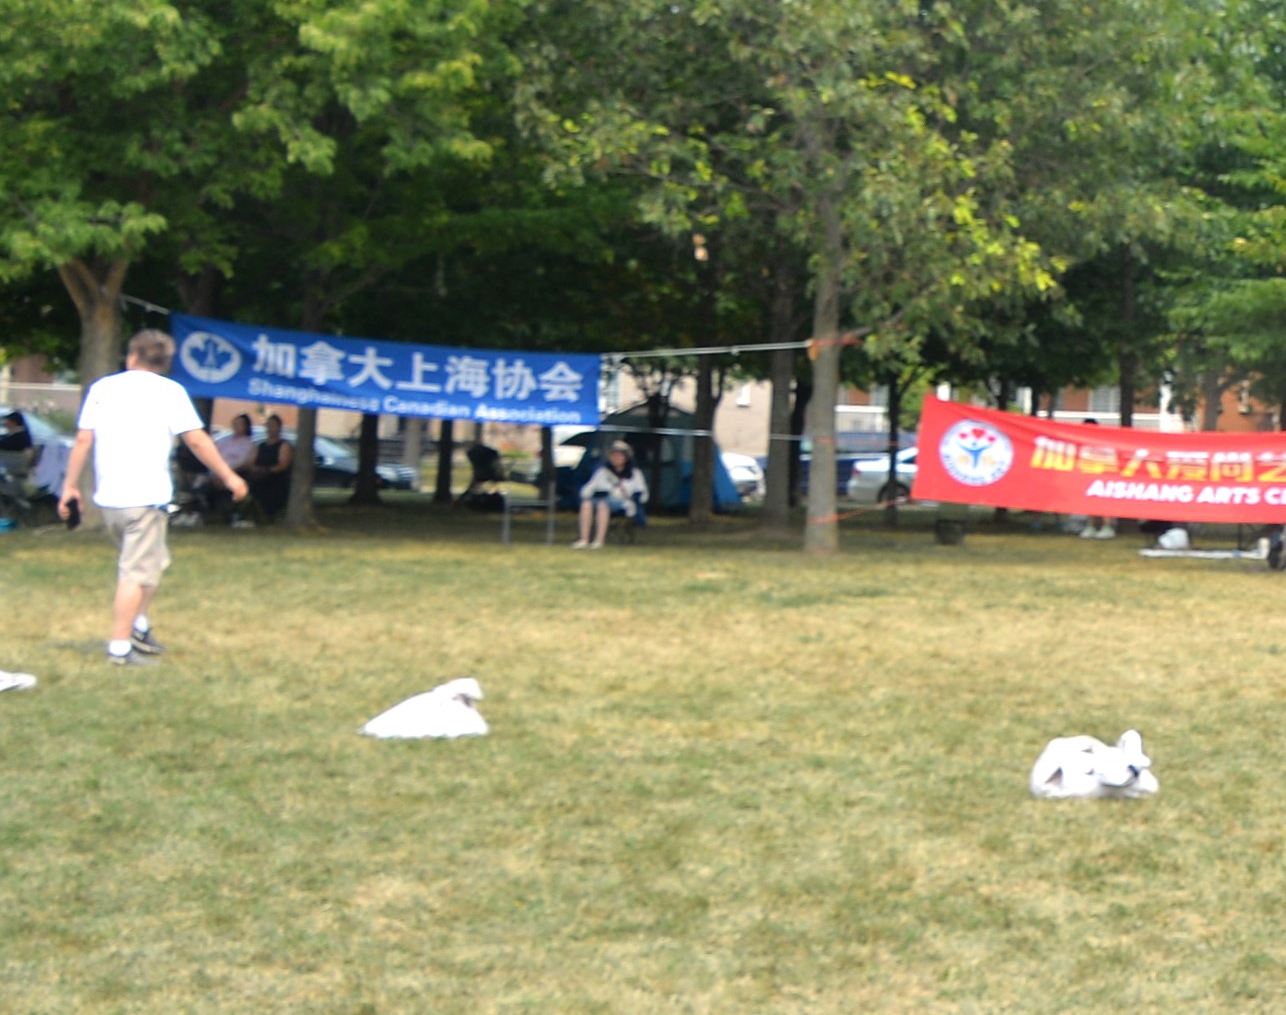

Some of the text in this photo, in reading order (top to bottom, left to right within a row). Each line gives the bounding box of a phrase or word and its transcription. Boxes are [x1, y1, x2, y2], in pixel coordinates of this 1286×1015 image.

[252, 333, 584, 404] 加拿大上海协会
[383, 395, 471, 418] Canadian
[474, 402, 582, 424] Association
[1086, 479, 1194, 503] AISHANG
[1197, 486, 1261, 505] ARTS
